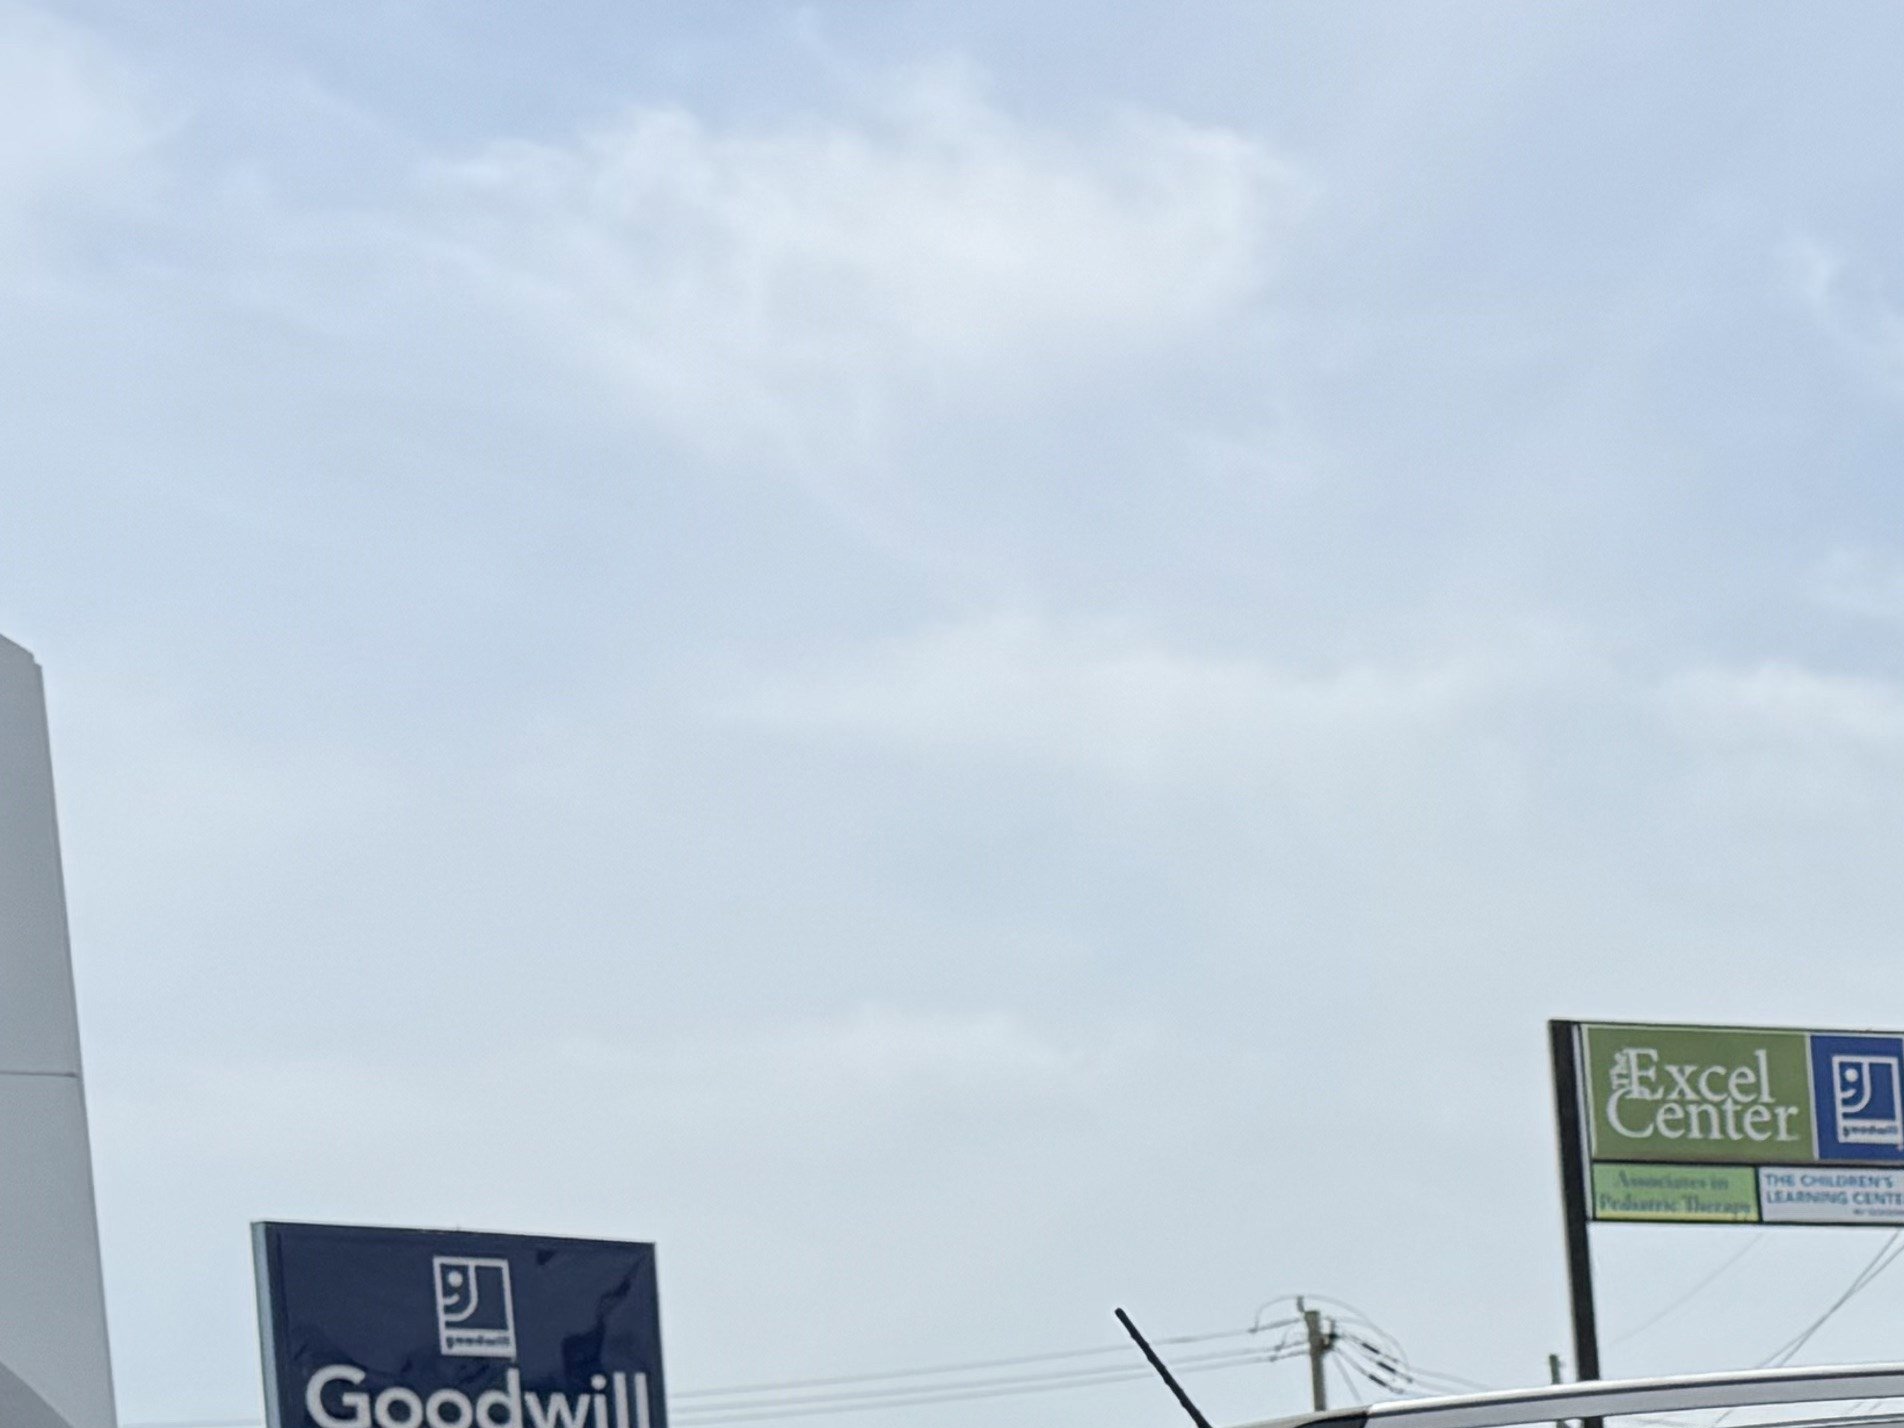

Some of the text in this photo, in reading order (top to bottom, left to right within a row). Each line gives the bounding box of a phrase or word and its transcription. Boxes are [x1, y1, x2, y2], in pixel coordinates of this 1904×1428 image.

[1625, 1048, 1775, 1104] Excel
[1607, 1088, 1800, 1141] Center
[1765, 1174, 1893, 1189] THE CHILDREN'S
[1767, 1190, 1848, 1206] LEARNING
